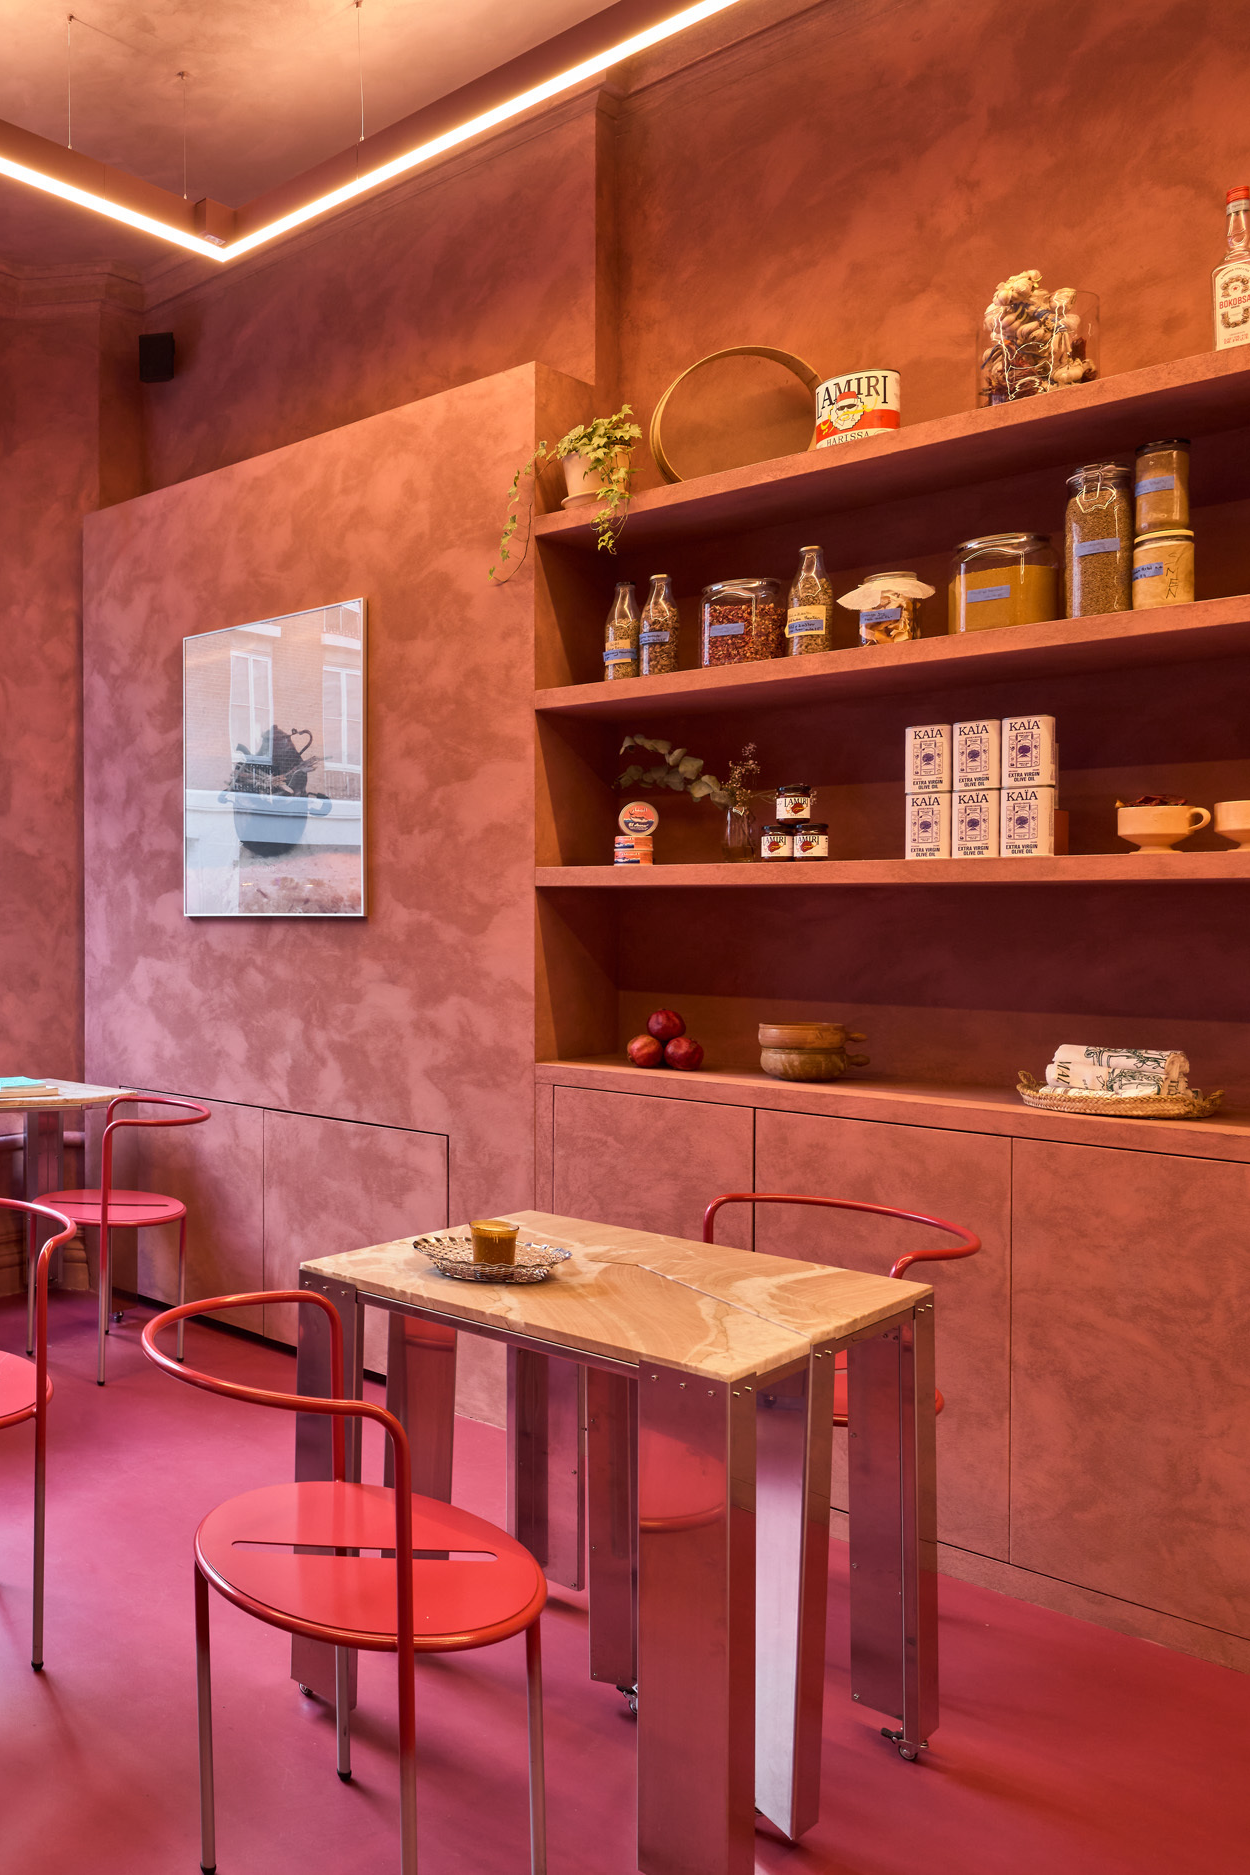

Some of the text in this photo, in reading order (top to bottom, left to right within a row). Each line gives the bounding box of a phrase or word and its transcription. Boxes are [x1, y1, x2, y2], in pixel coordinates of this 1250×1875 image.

[1219, 294, 1250, 309] BOKOBSA
[816, 375, 888, 420] LAMIRI
[826, 431, 869, 446] HARISSA
[958, 724, 989, 736] KAÏA
[1009, 719, 1041, 731] KAÏA
[913, 728, 943, 739] KAÏA
[911, 796, 940, 807] KAÏA
[958, 793, 989, 804] KAÏA
[1006, 790, 1038, 801] KAÏA
